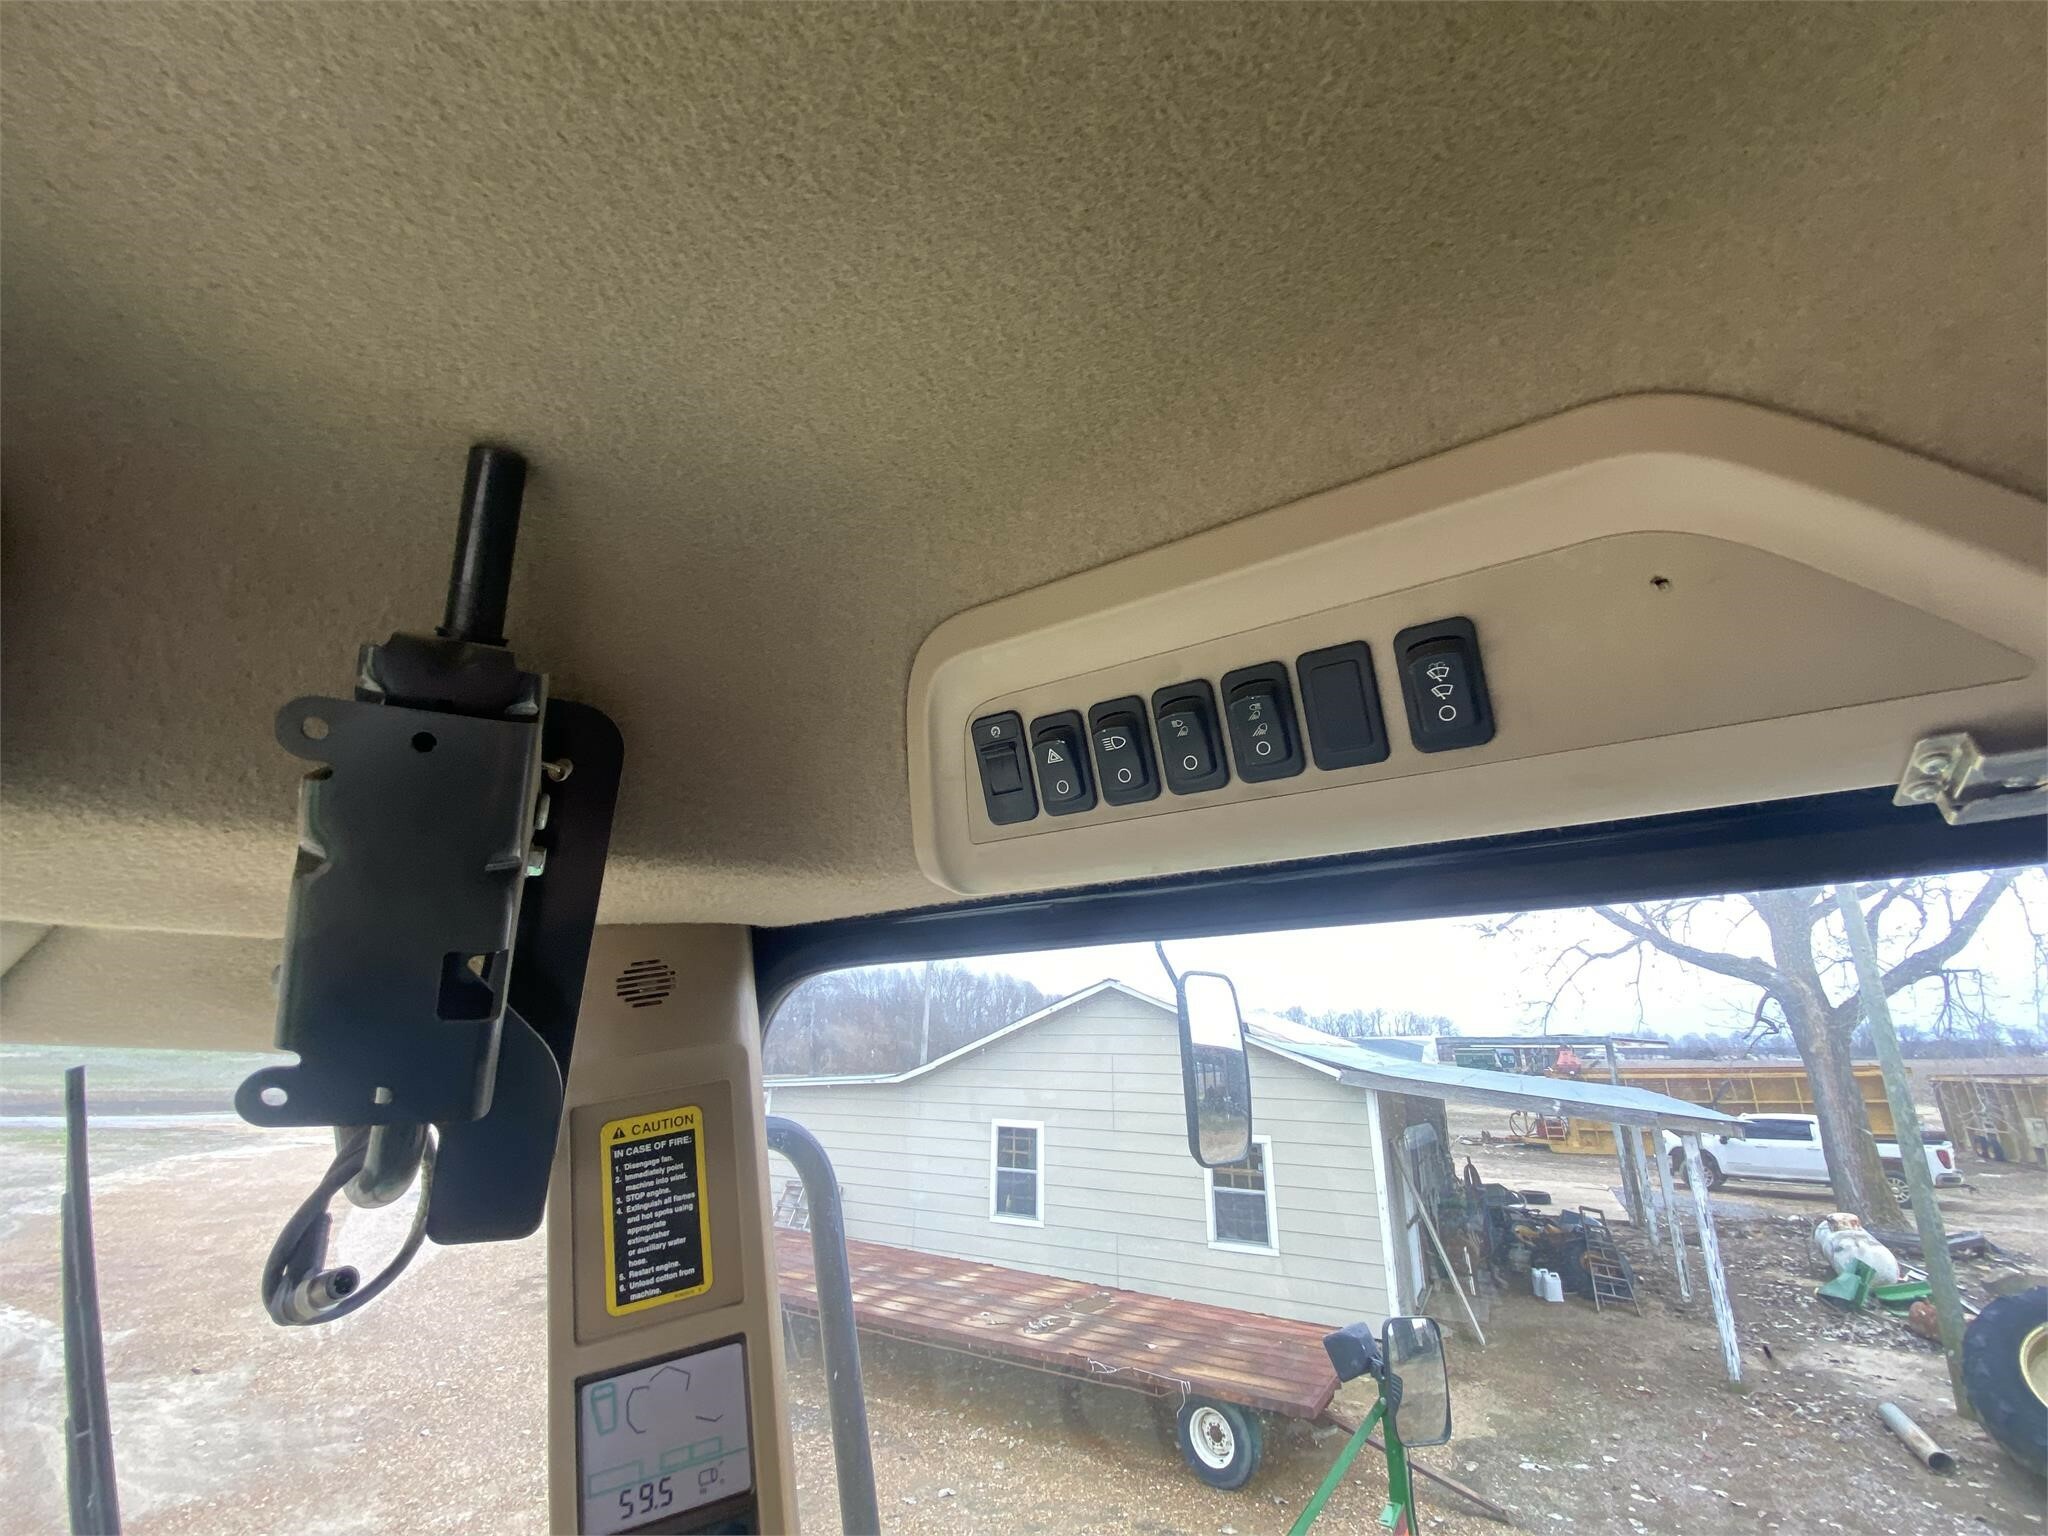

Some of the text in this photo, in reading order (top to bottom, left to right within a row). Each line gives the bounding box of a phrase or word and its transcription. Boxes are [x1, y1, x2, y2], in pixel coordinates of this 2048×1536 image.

[632, 1113, 694, 1136] CAUTION
[613, 1135, 692, 1158] IN CASE OF FIRE:
[624, 1158, 660, 1171] Disengage
[661, 1155, 674, 1163] fan.
[624, 1167, 664, 1181] Immediately
[666, 1162, 684, 1174] point
[626, 1172, 688, 1192] machine into wind.
[626, 1192, 645, 1202] STOP
[646, 1188, 671, 1198] engine.
[626, 1200, 662, 1213] Extinguish
[664, 1196, 672, 1204] all
[673, 1192, 695, 1202] flames
[627, 1215, 640, 1224] and
[654, 1208, 673, 1218] spots
[674, 1203, 693, 1212] using
[627, 1220, 666, 1235] appropriate
[627, 1230, 670, 1246] extinguisher
[637, 1242, 666, 1254] auxiliary
[668, 1237, 686, 1247] water
[628, 1258, 648, 1268] hose.
[629, 1266, 654, 1278] Restart
[655, 1261, 680, 1271] engine.
[630, 1277, 654, 1289] Unload
[656, 1272, 677, 1283] cotton
[679, 1268, 695, 1277] from
[630, 1287, 662, 1301] machine.
[619, 1476, 673, 1520] 59.5
